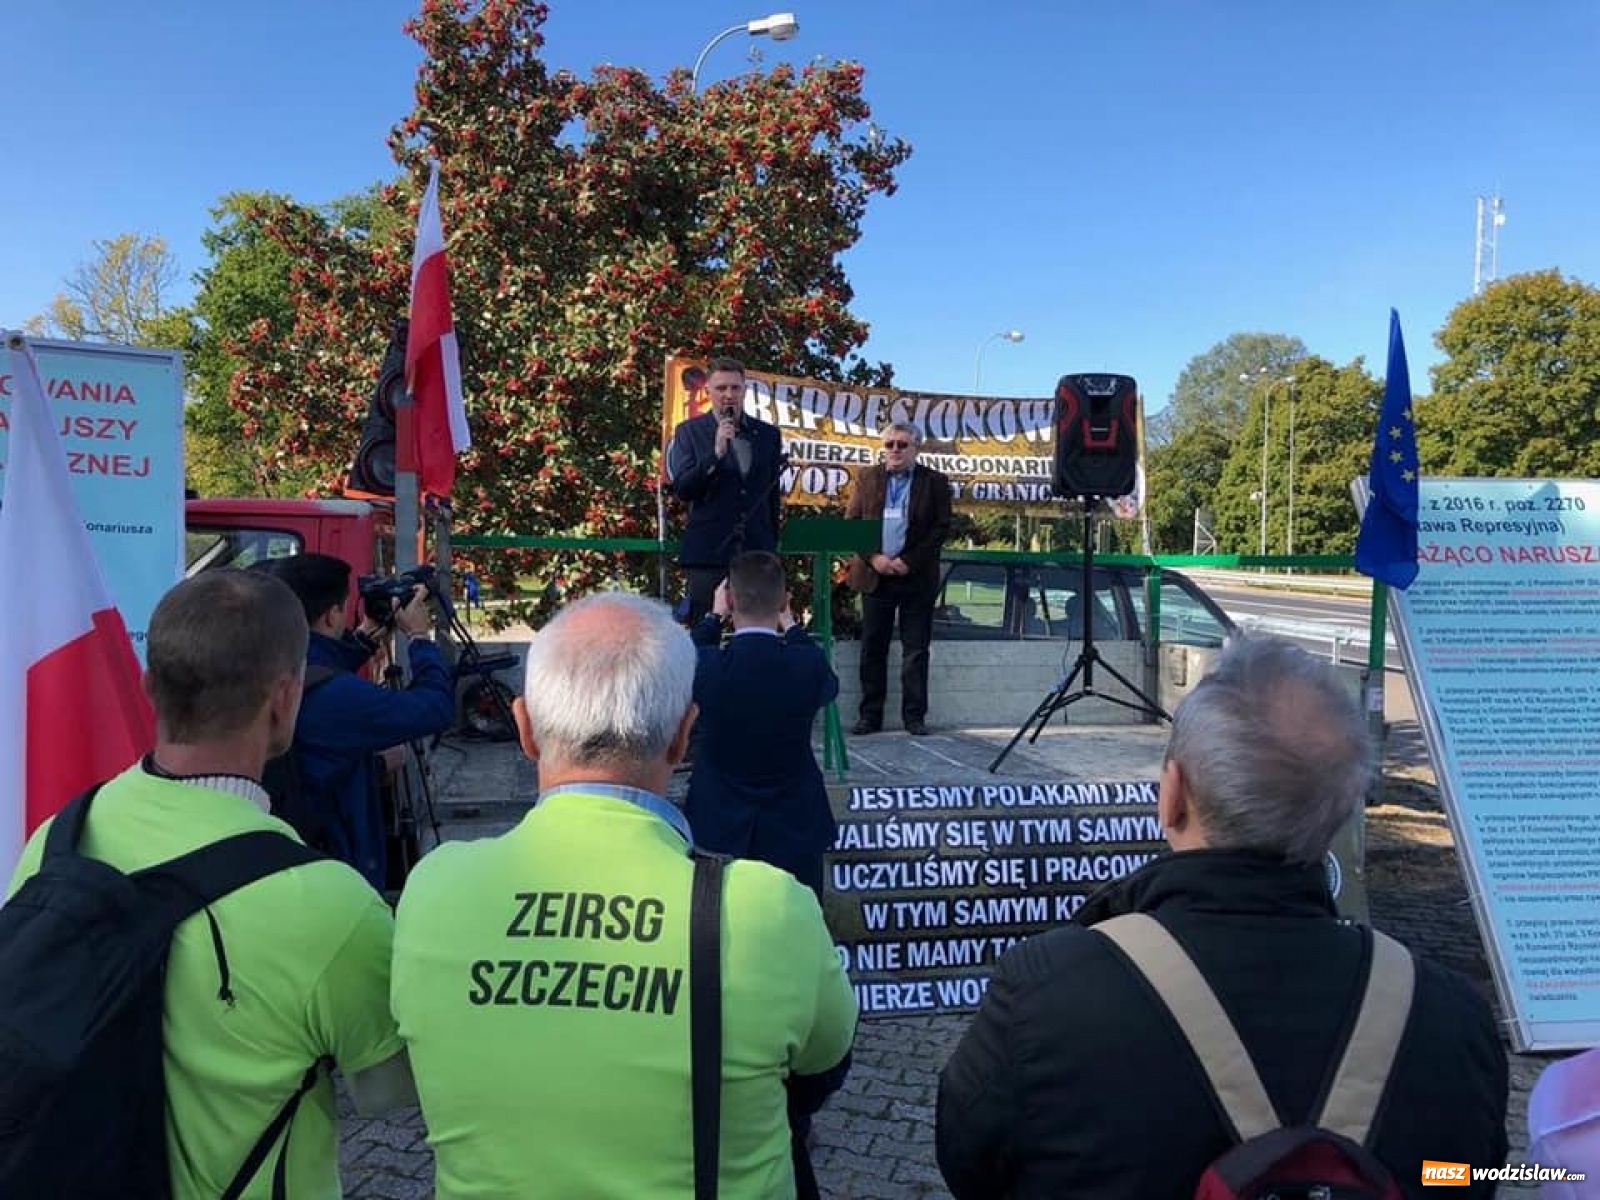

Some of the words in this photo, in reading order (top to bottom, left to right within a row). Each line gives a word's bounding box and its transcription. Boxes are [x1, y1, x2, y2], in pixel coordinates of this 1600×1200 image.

[66, 452, 150, 477] ZNEJ
[785, 441, 871, 464] NIERZE
[972, 481, 1052, 501] GRANIC
[1443, 497, 1484, 511] 2016
[1544, 497, 1585, 511] 2270
[81, 520, 153, 534] onariusza
[1417, 520, 1456, 533] tawa
[1461, 518, 1565, 535] Represyjna)
[1417, 542, 1493, 567] AŻĄCO
[1499, 545, 1600, 563] NARUSZ
[983, 783, 1109, 807] POLAKAMI
[946, 821, 988, 851] SIĘ
[992, 820, 1014, 845] W
[1019, 818, 1071, 844] TYM
[1078, 815, 1167, 842] SAMYM
[833, 857, 978, 891] UCZYLIŚMY
[984, 862, 1027, 890] SIĘ
[1031, 858, 1038, 882] I
[506, 893, 665, 942] ZEIRSG
[864, 904, 888, 931] W
[893, 901, 947, 928] TYM
[954, 897, 1047, 926] SAMYM
[857, 943, 901, 971] NIE
[907, 939, 986, 968] MAMY
[469, 960, 683, 1015] SZCZECIN
